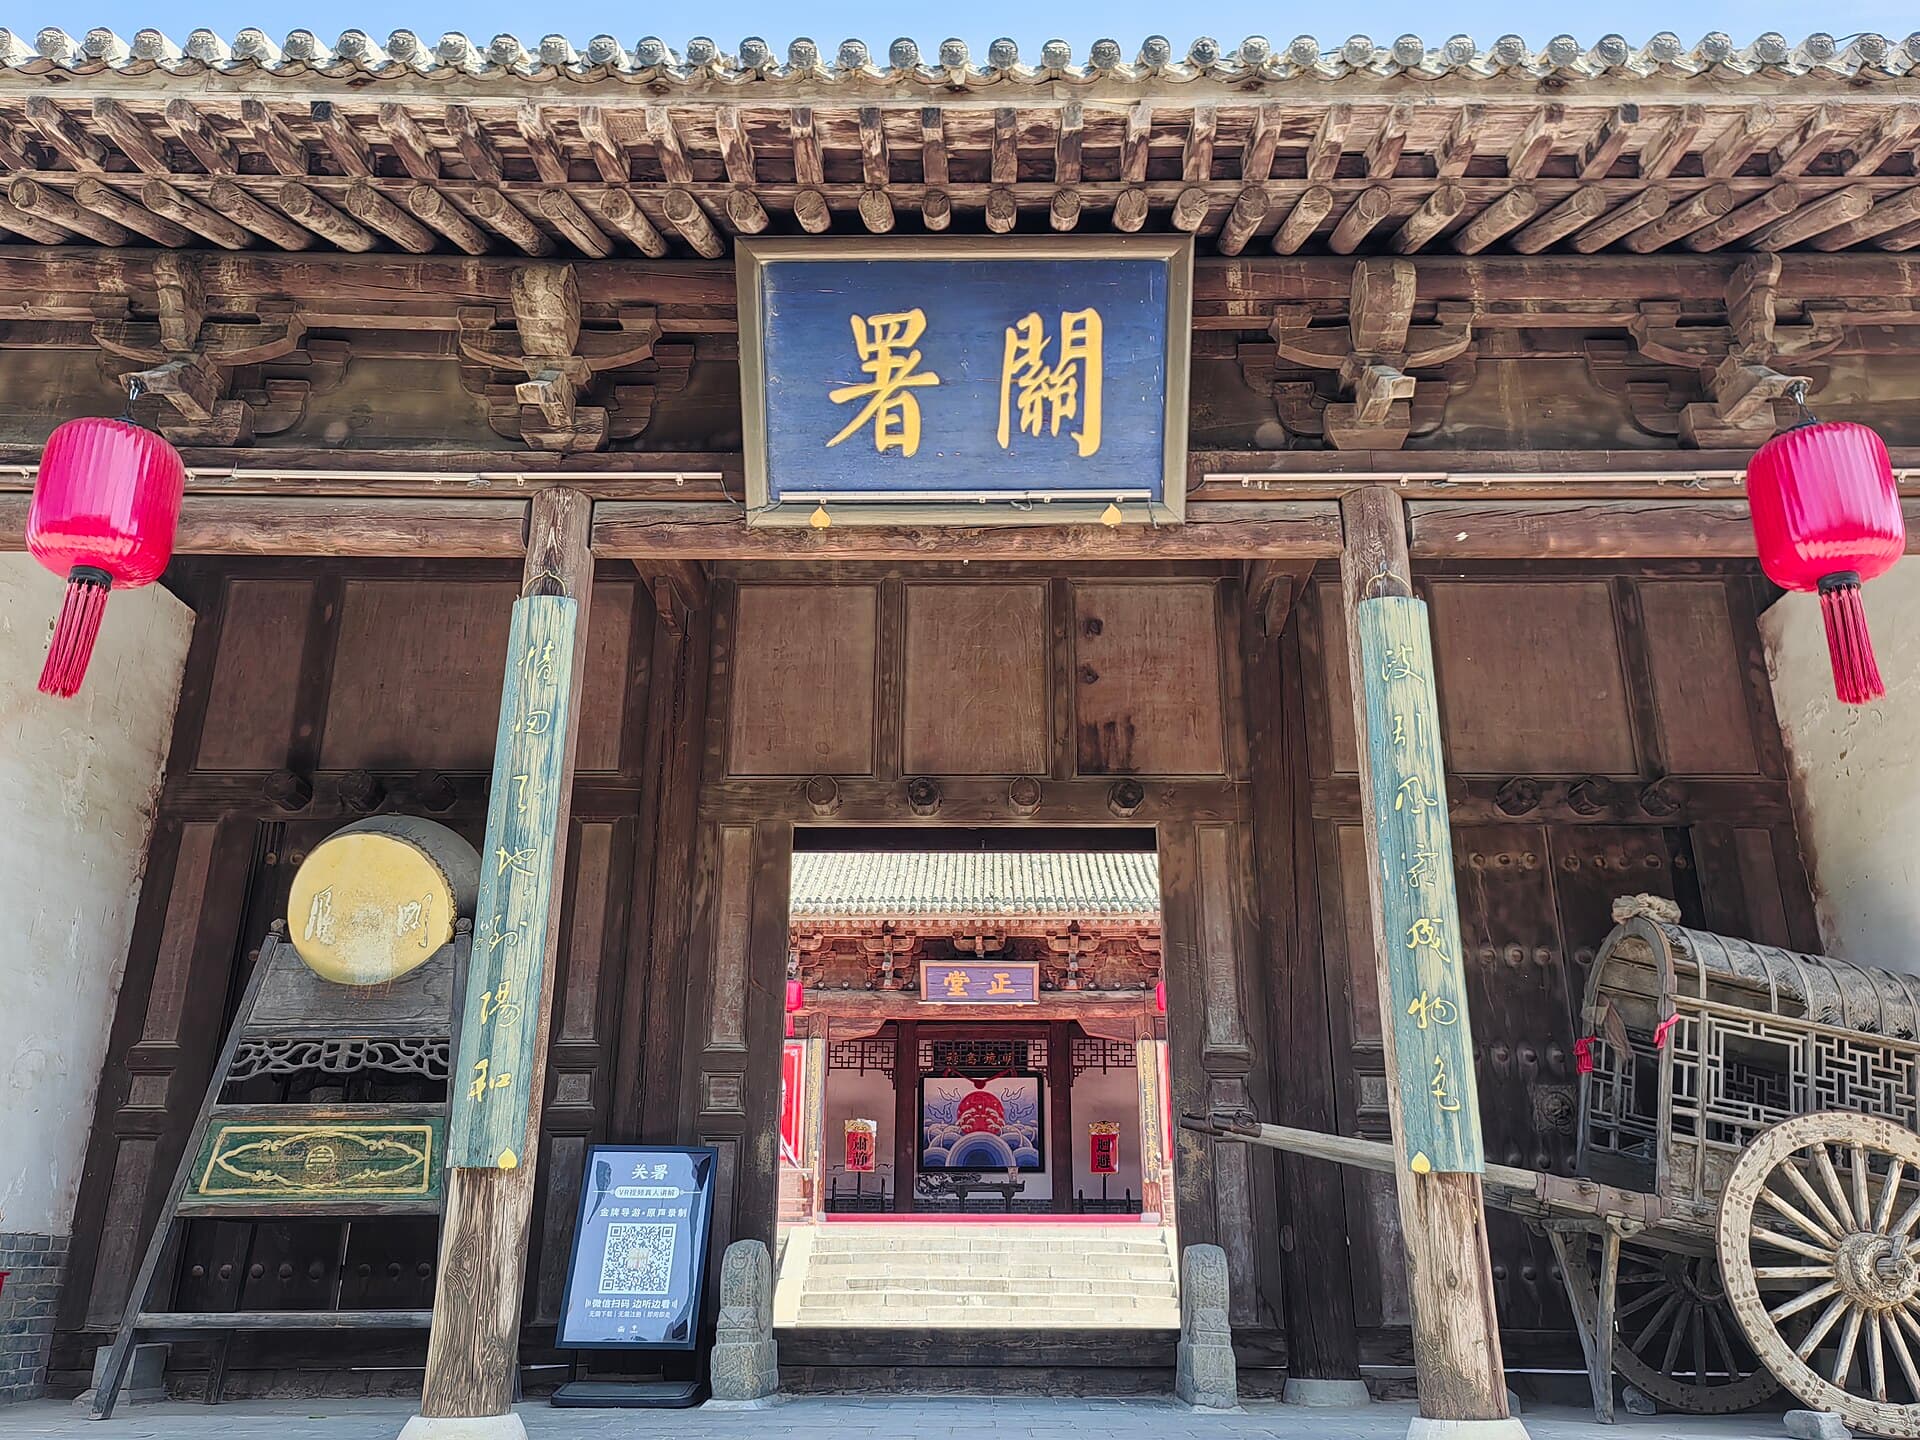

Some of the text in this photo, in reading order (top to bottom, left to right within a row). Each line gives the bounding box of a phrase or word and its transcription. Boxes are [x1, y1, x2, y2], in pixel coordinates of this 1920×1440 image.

[631, 1163, 669, 1181] 关署
[592, 1298, 670, 1309] 微信扫码 边听边看
